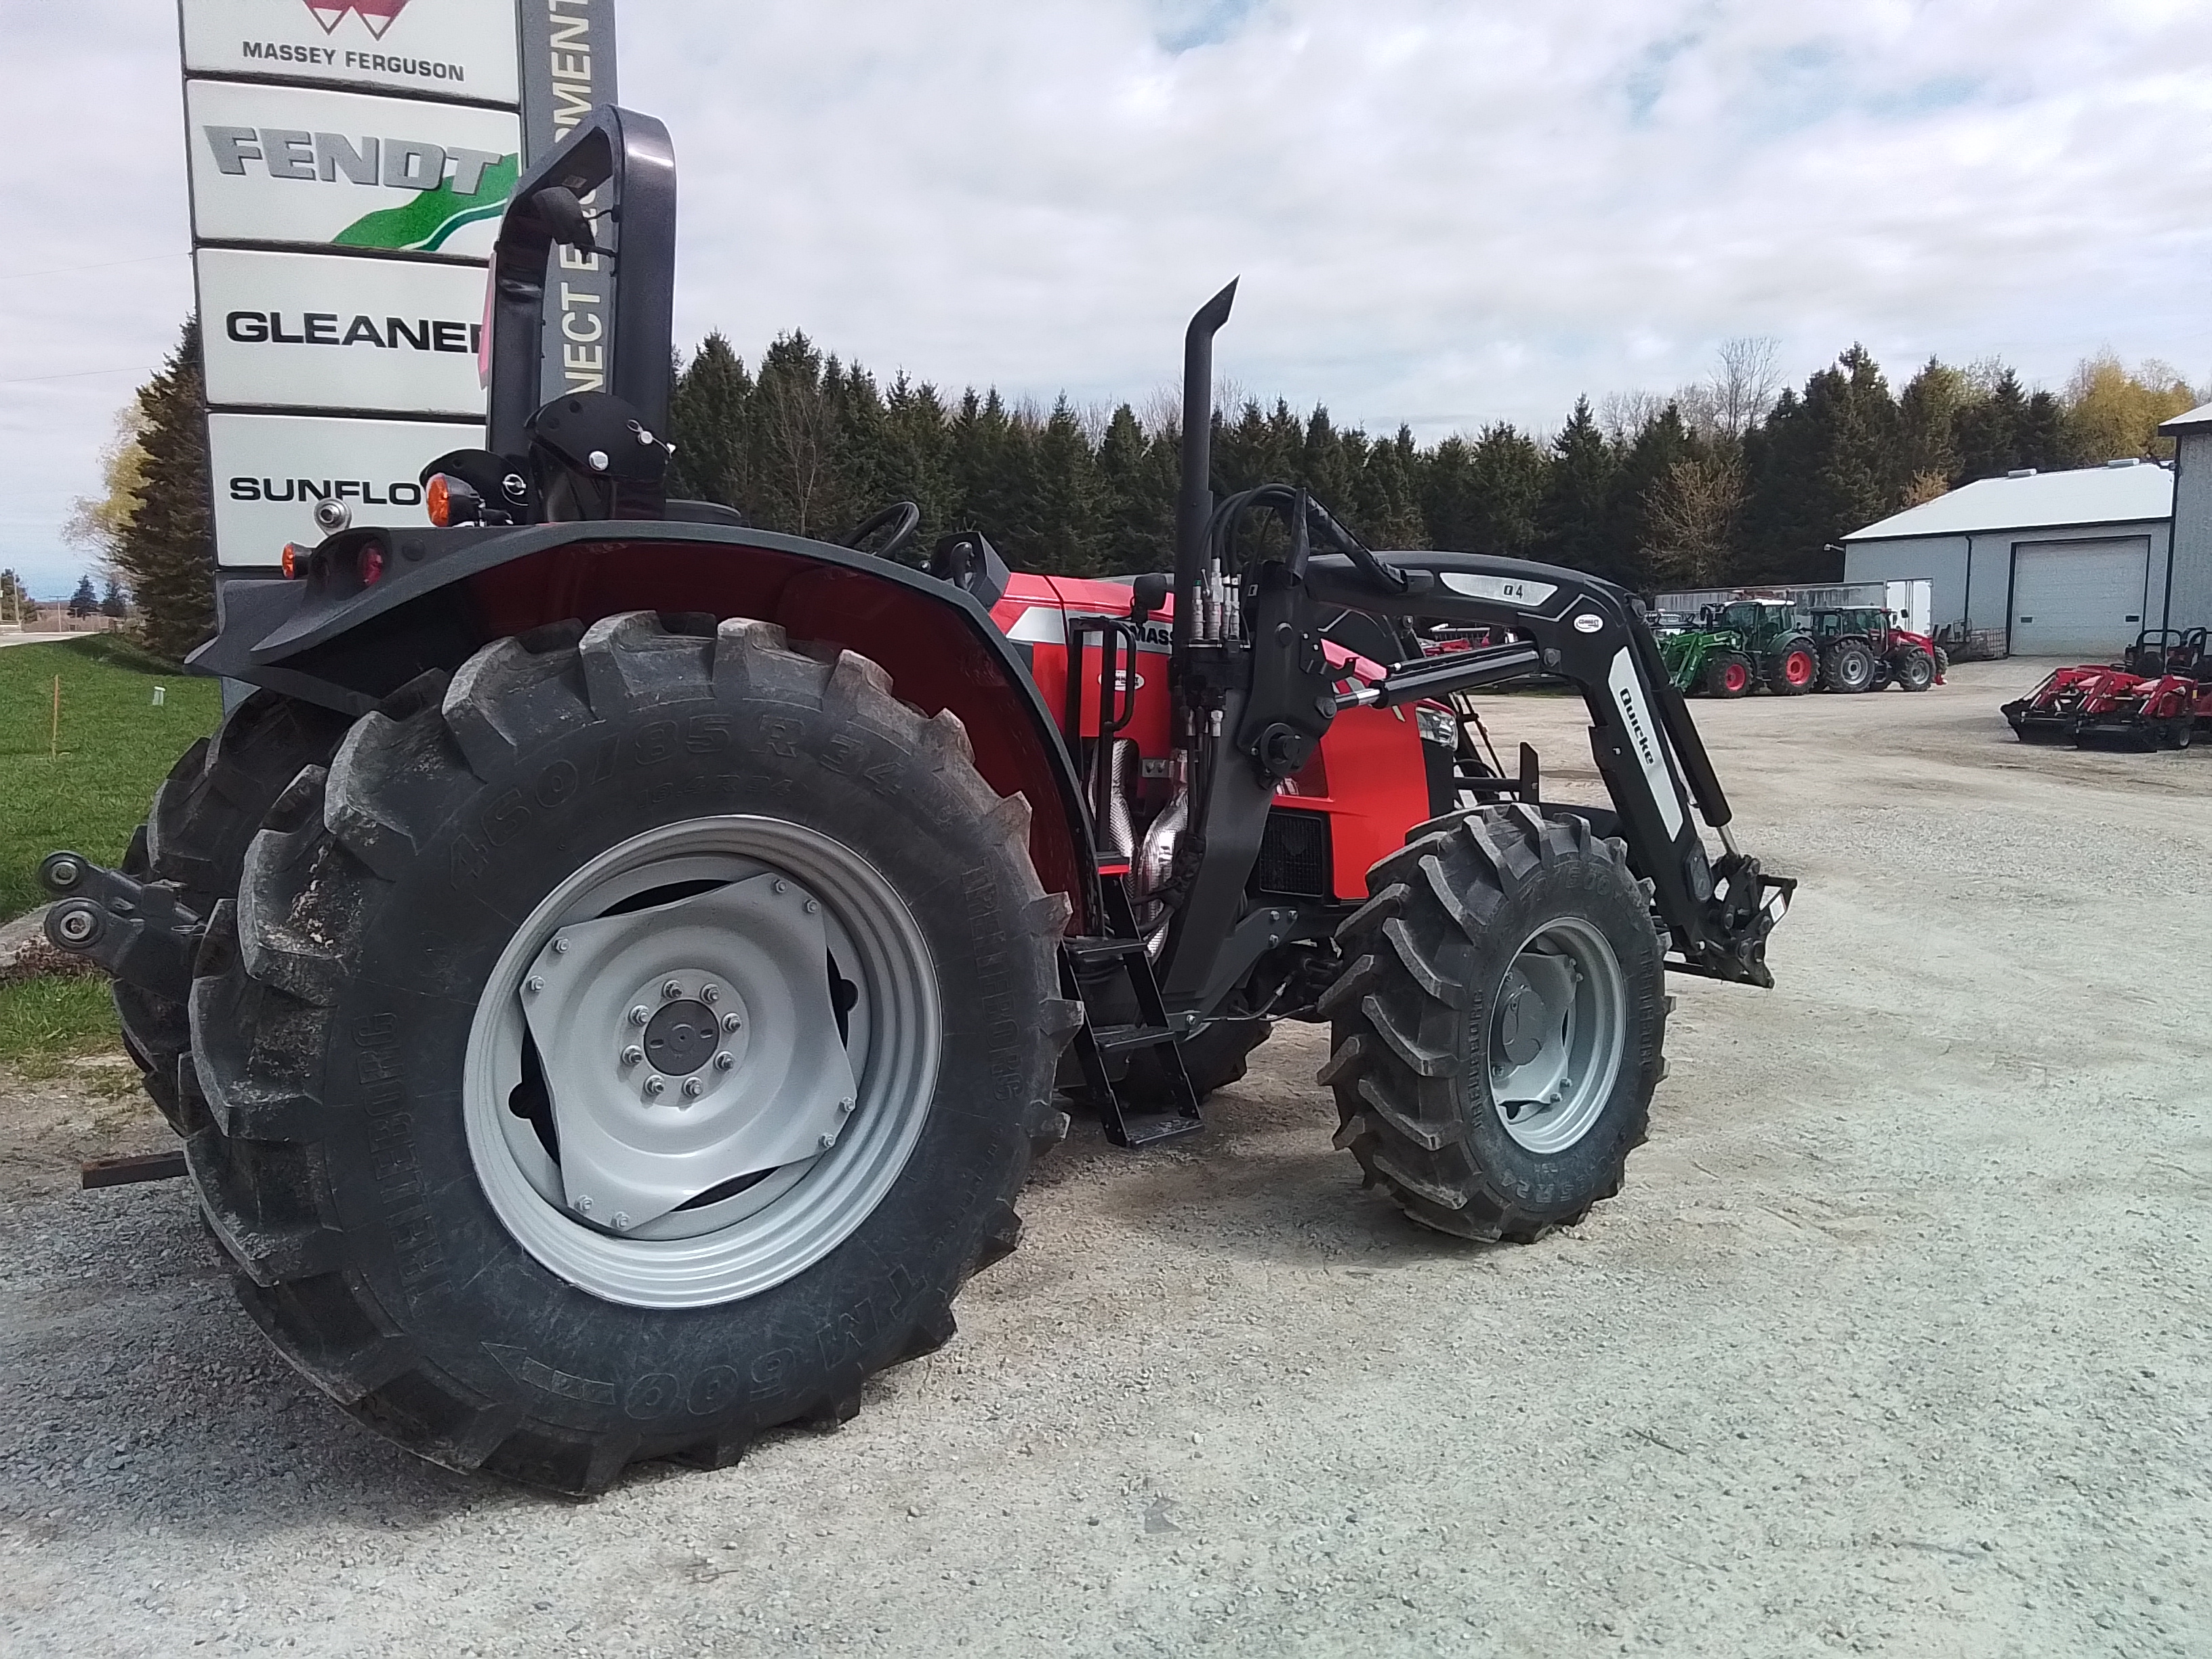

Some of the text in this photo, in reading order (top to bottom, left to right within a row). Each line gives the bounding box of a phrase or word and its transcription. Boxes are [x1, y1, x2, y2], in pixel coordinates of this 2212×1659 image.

[242, 41, 465, 82] MASSEY FERGUSON
[203, 125, 504, 196] FENDT
[561, 282, 602, 394] NECT
[229, 476, 421, 506] SUNFLO
[1129, 625, 1174, 647] MAS
[1619, 687, 1654, 765] Quicke
[352, 1011, 456, 1319] TRELLEBORG
